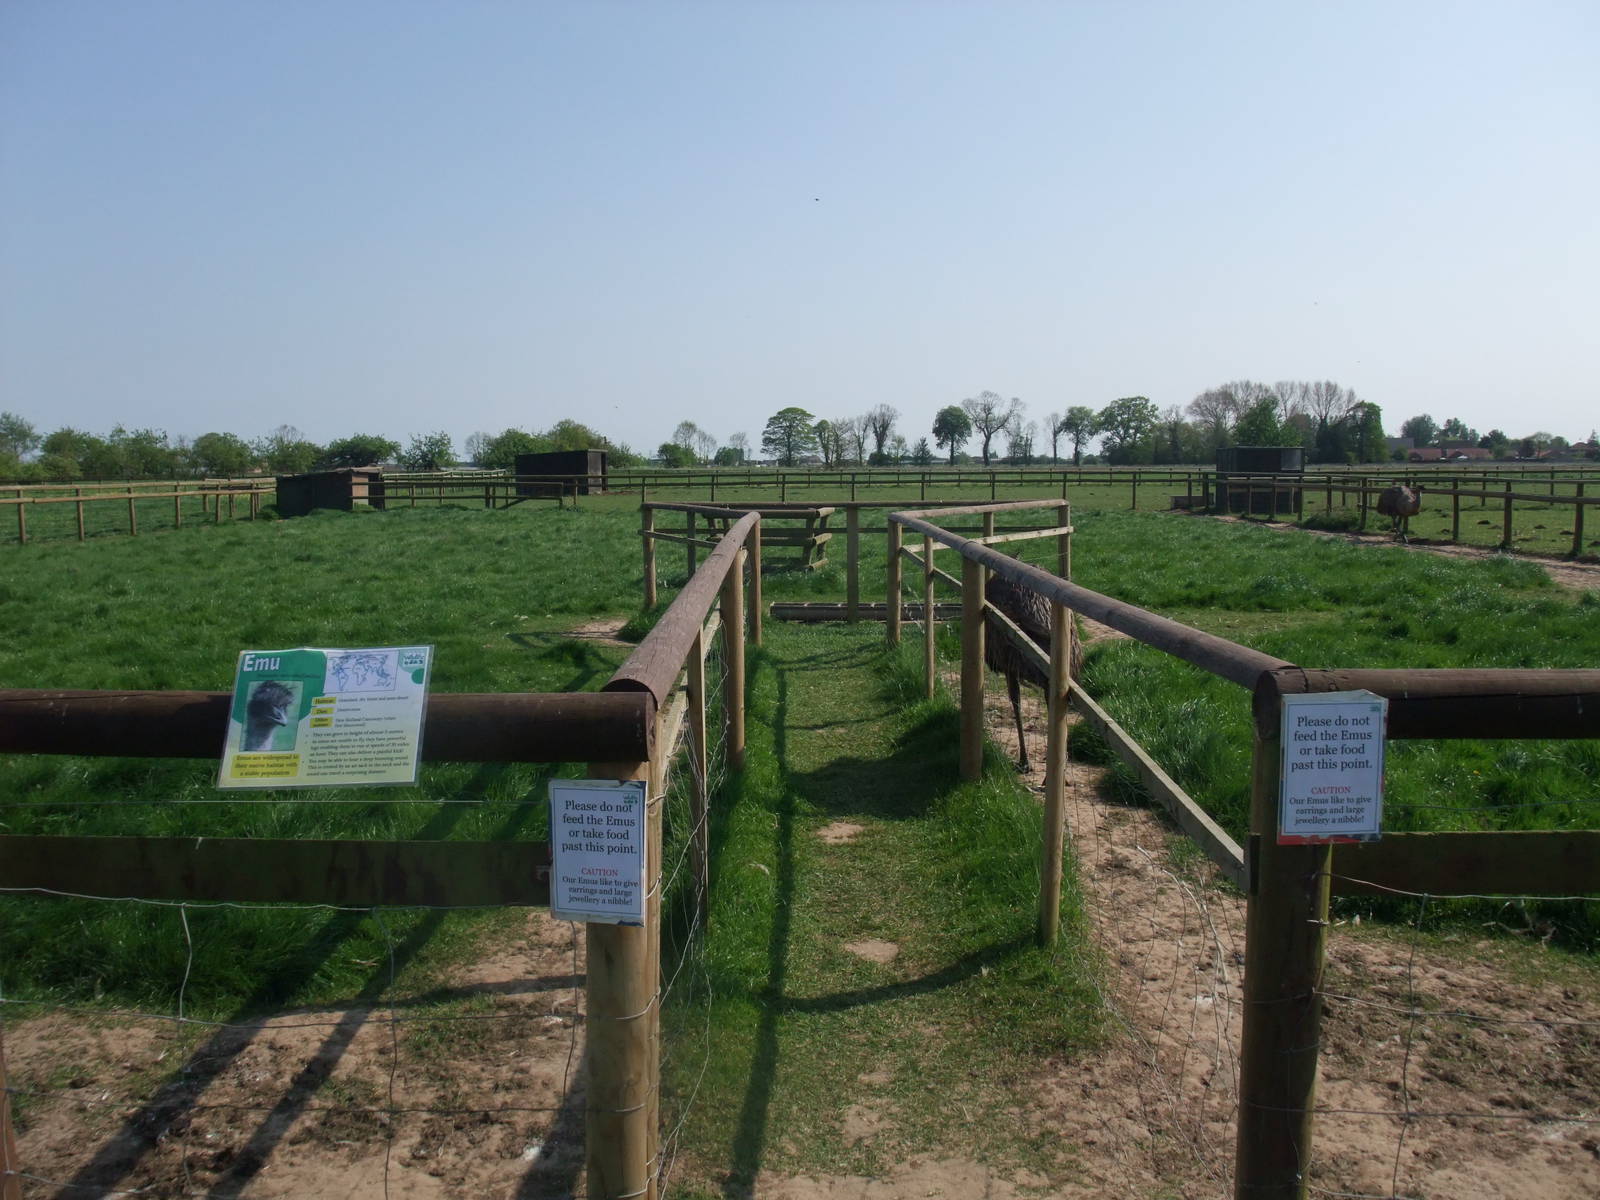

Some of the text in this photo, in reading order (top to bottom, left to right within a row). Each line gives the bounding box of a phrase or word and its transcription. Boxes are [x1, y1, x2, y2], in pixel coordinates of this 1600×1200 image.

[243, 654, 280, 672] Emu
[1297, 715, 1369, 726] Please do not
[1295, 731, 1372, 741] feed the Emus
[1315, 745, 1337, 755] take
[1341, 744, 1365, 754] food
[1292, 759, 1372, 772] past this point.
[566, 800, 632, 812] Please do not
[1290, 797, 1303, 805] Our
[1331, 796, 1344, 804] like
[1356, 796, 1372, 805] give
[1296, 805, 1364, 816] earrings and large
[563, 813, 635, 826] feed the Emus
[1295, 817, 1328, 826] jewellery
[1338, 815, 1364, 824] nibble!
[583, 828, 604, 839] take
[607, 830, 629, 840] food
[562, 842, 637, 855] past this point.
[582, 868, 618, 876] CAUTION
[579, 877, 598, 885] Emus
[600, 877, 612, 885] like
[624, 880, 638, 888] give
[569, 887, 632, 897] earrings and large
[568, 895, 599, 905] jewellery
[608, 896, 632, 905] nibble!
